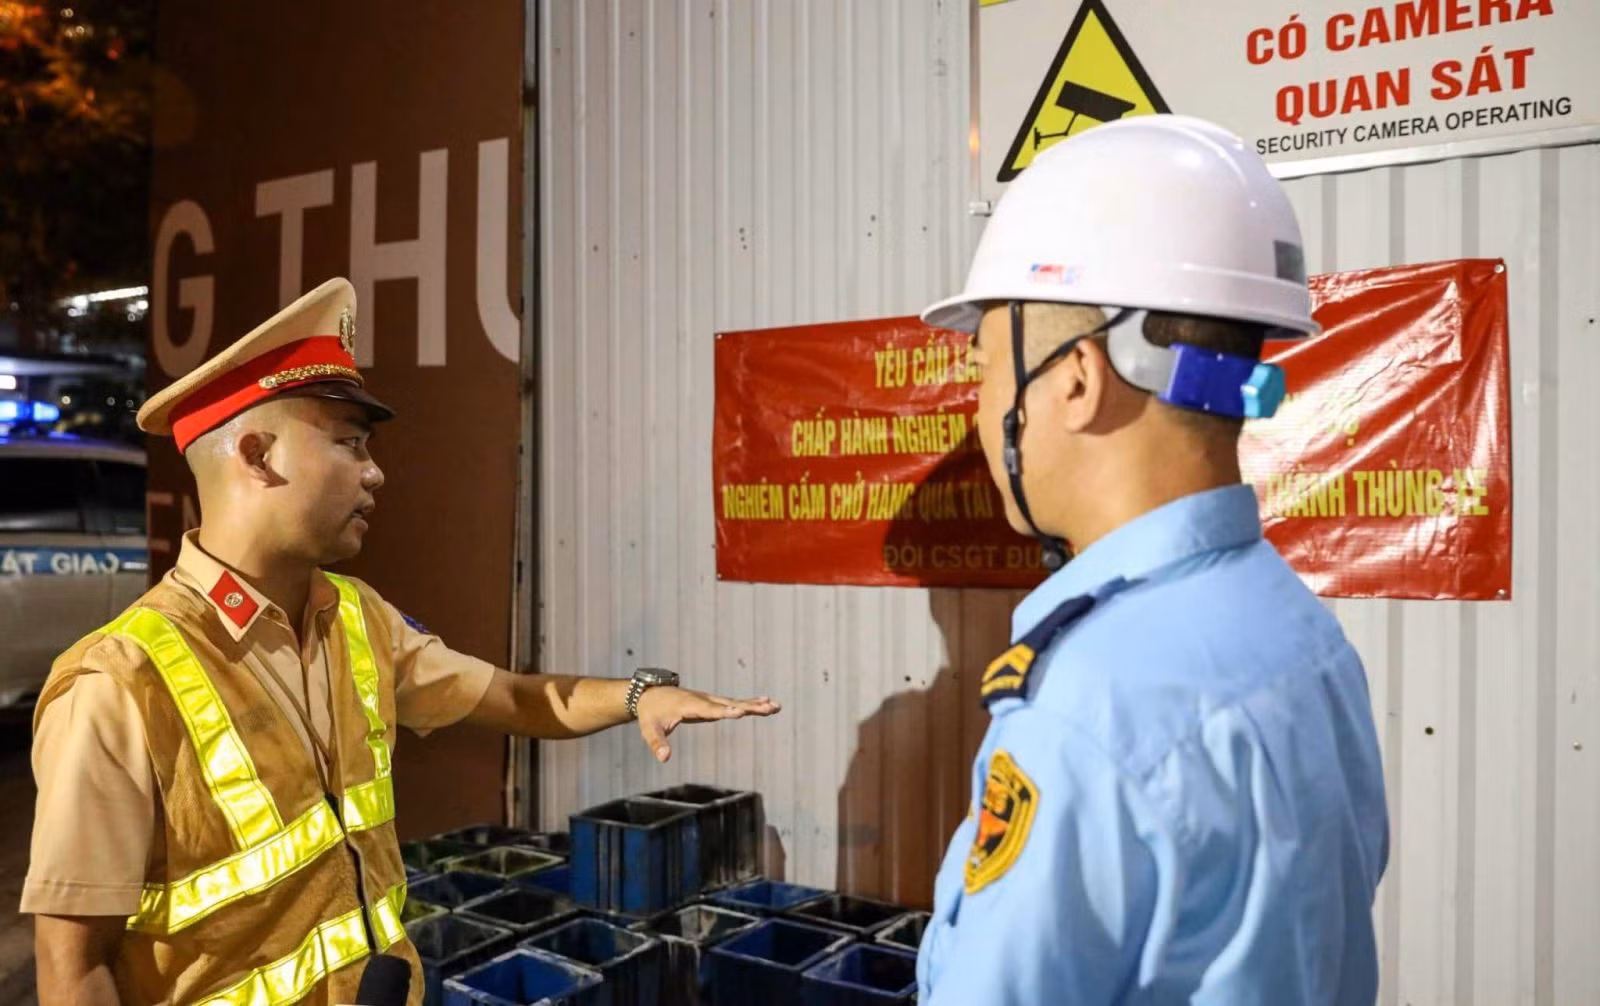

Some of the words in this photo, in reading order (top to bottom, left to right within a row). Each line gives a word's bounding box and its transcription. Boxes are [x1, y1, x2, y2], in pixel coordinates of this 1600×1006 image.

[1246, 14, 1307, 65] CÓ
[1275, 67, 1410, 126] QUAN
[1430, 45, 1535, 102] SÁT
[1255, 127, 1348, 155] SECURITY
[1353, 115, 1440, 142] CAMERA
[1444, 97, 1573, 130] OPERATING
[874, 341, 908, 389] YÊU
[840, 409, 889, 455] HÀNH
[1352, 459, 1443, 517] THÙNG
